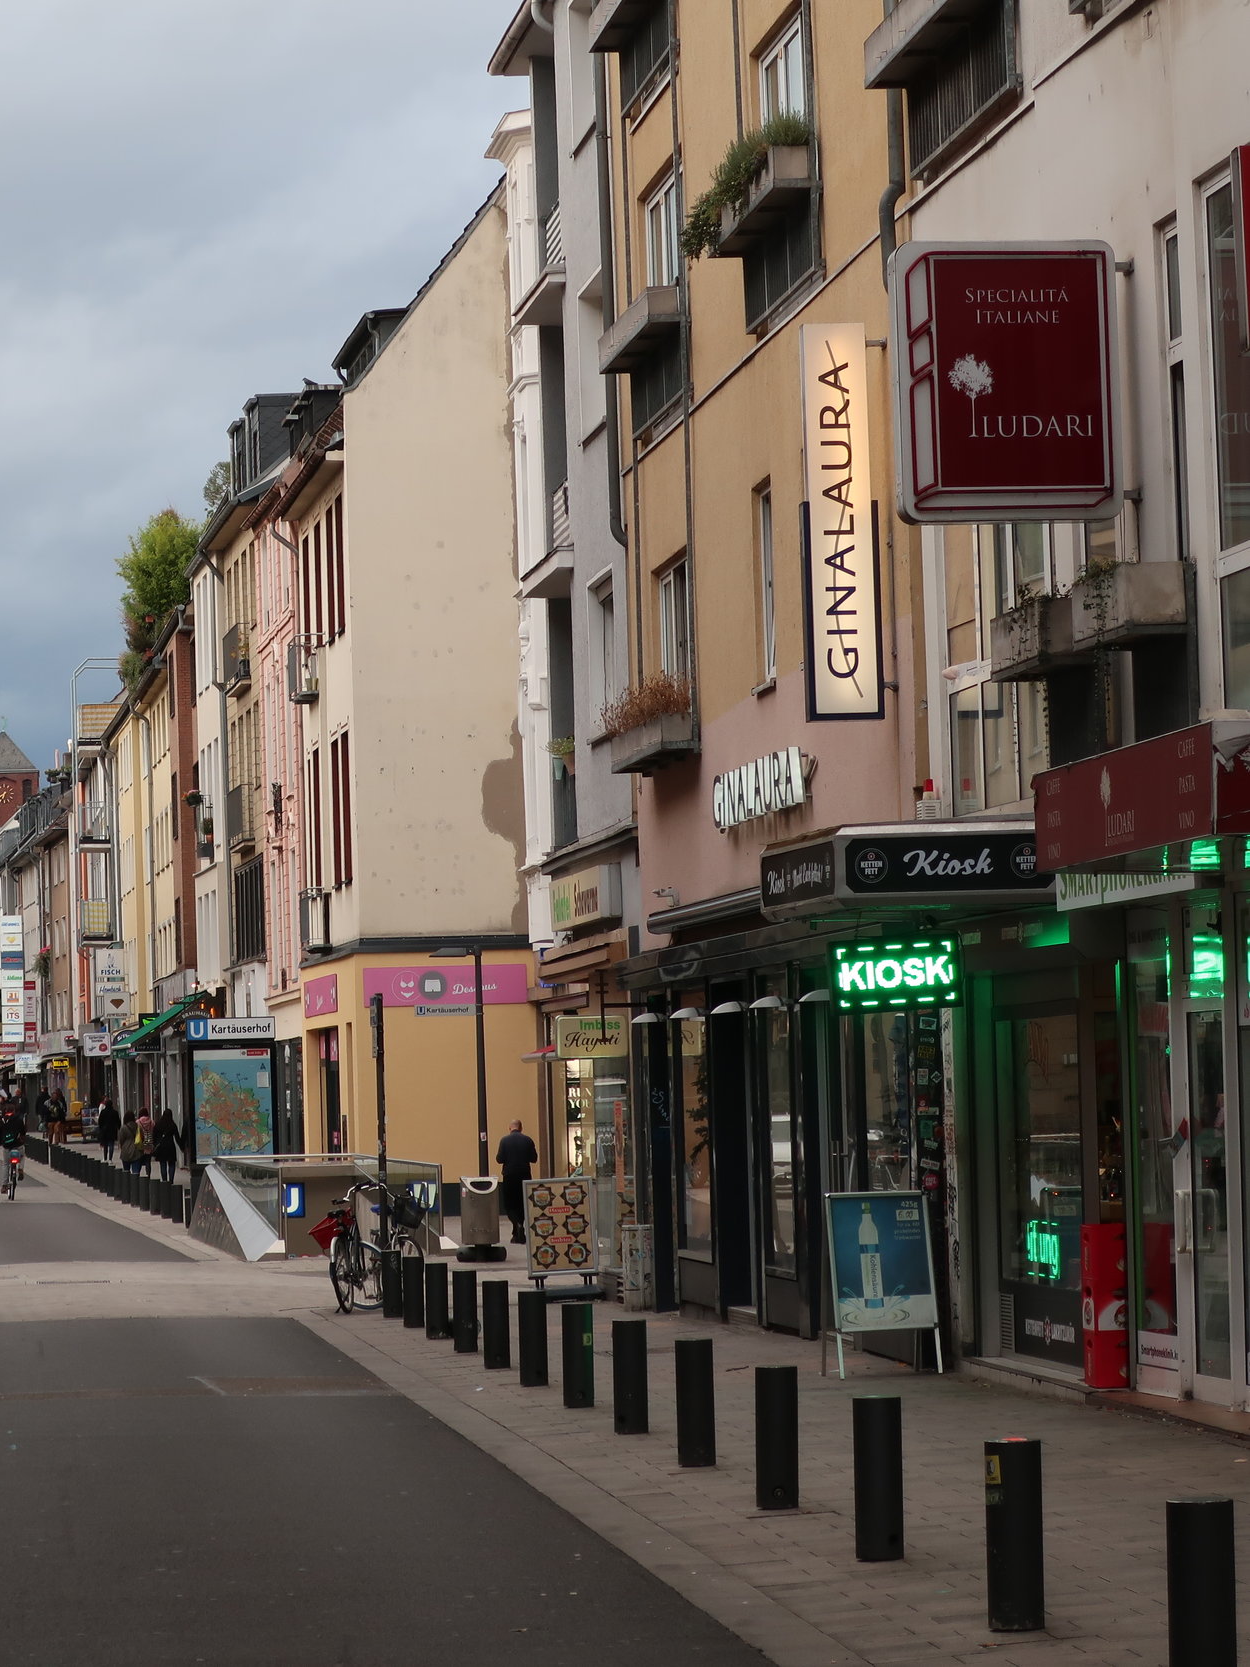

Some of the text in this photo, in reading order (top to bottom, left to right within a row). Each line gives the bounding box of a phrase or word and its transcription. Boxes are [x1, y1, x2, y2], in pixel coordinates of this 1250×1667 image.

[976, 309, 1060, 324] ITALIANE
[818, 362, 859, 678] GINALAURA
[713, 747, 806, 828] GINALAURA
[860, 860, 883, 868] KETTEN
[903, 848, 994, 877] Kiosk
[864, 867, 879, 875] FETT
[840, 956, 950, 991] KIOSK
[6, 1012, 20, 1020] ITS
[426, 1006, 470, 1014] Kartäuserhof
[190, 1021, 271, 1039] U Kartäuserhof
[580, 1020, 620, 1030] Imbss
[869, 1254, 879, 1298] Kohlensäure
